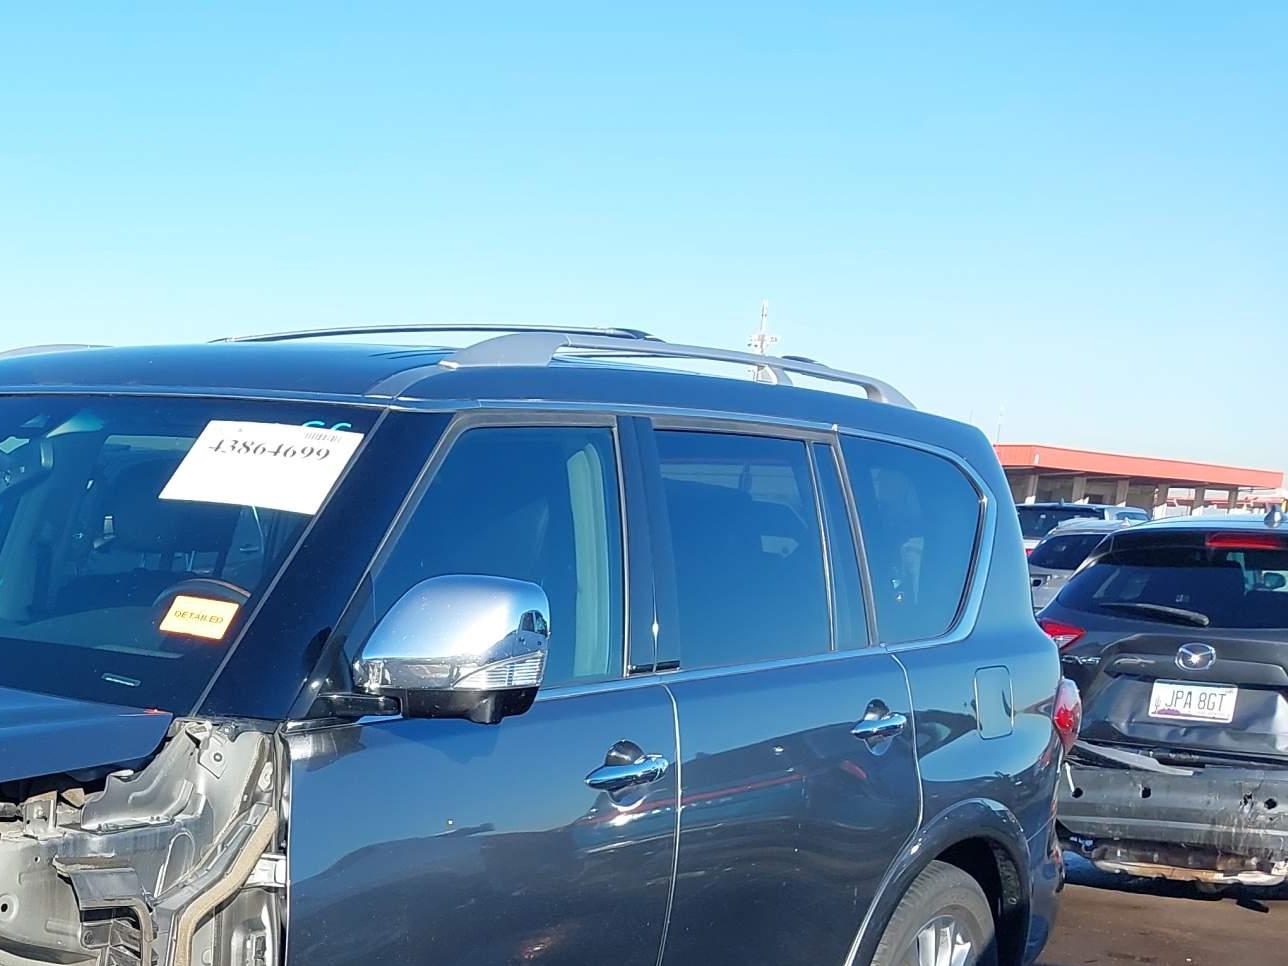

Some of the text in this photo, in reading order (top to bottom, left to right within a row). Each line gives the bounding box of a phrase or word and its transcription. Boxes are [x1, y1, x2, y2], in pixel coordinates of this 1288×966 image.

[207, 439, 331, 461] 43864699
[173, 610, 224, 624] DETAILED
[1164, 689, 1227, 712] JPA 8GT
